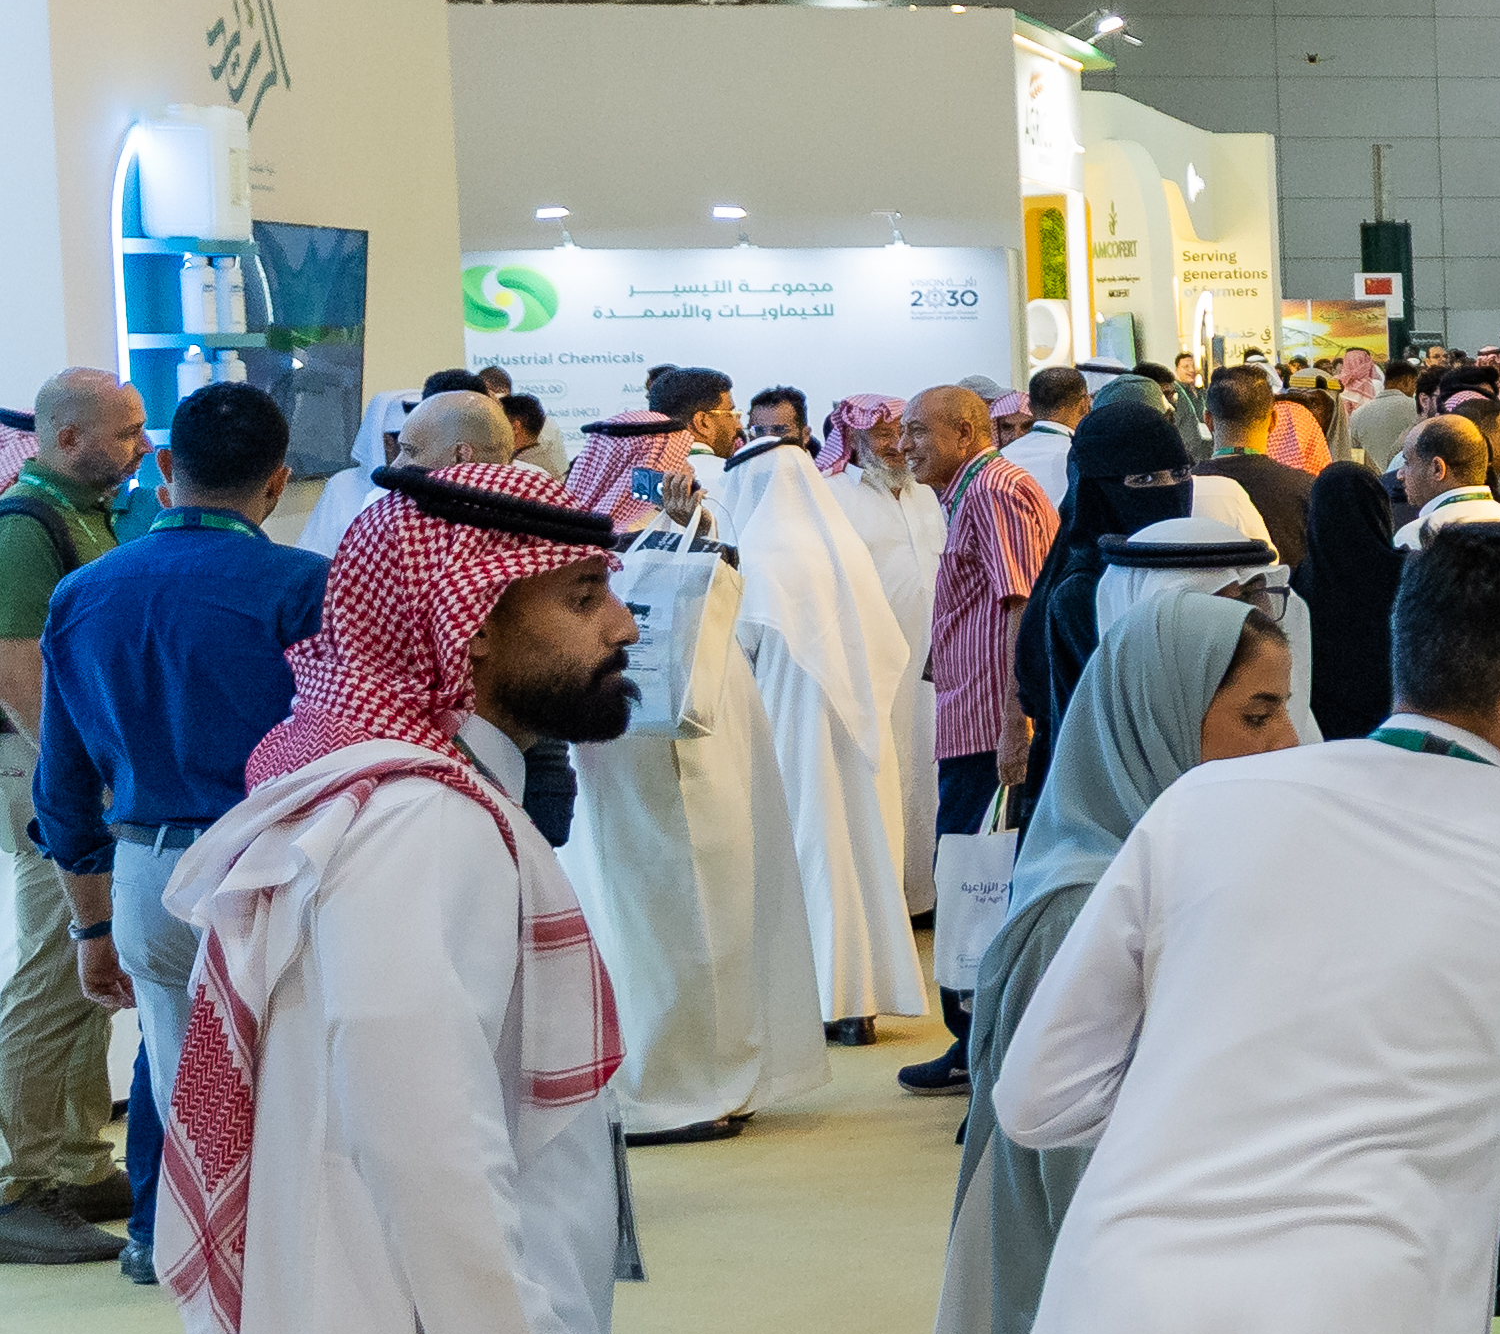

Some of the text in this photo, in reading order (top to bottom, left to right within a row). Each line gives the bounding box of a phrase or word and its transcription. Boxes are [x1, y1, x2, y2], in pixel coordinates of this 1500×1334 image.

[1182, 251, 1237, 264] Serving
[1183, 268, 1268, 282] generations
[629, 280, 833, 297] مجموعة التيسير
[593, 303, 834, 321] للكيماويات والأسمدة
[472, 351, 644, 367] Industrial Chemicals
